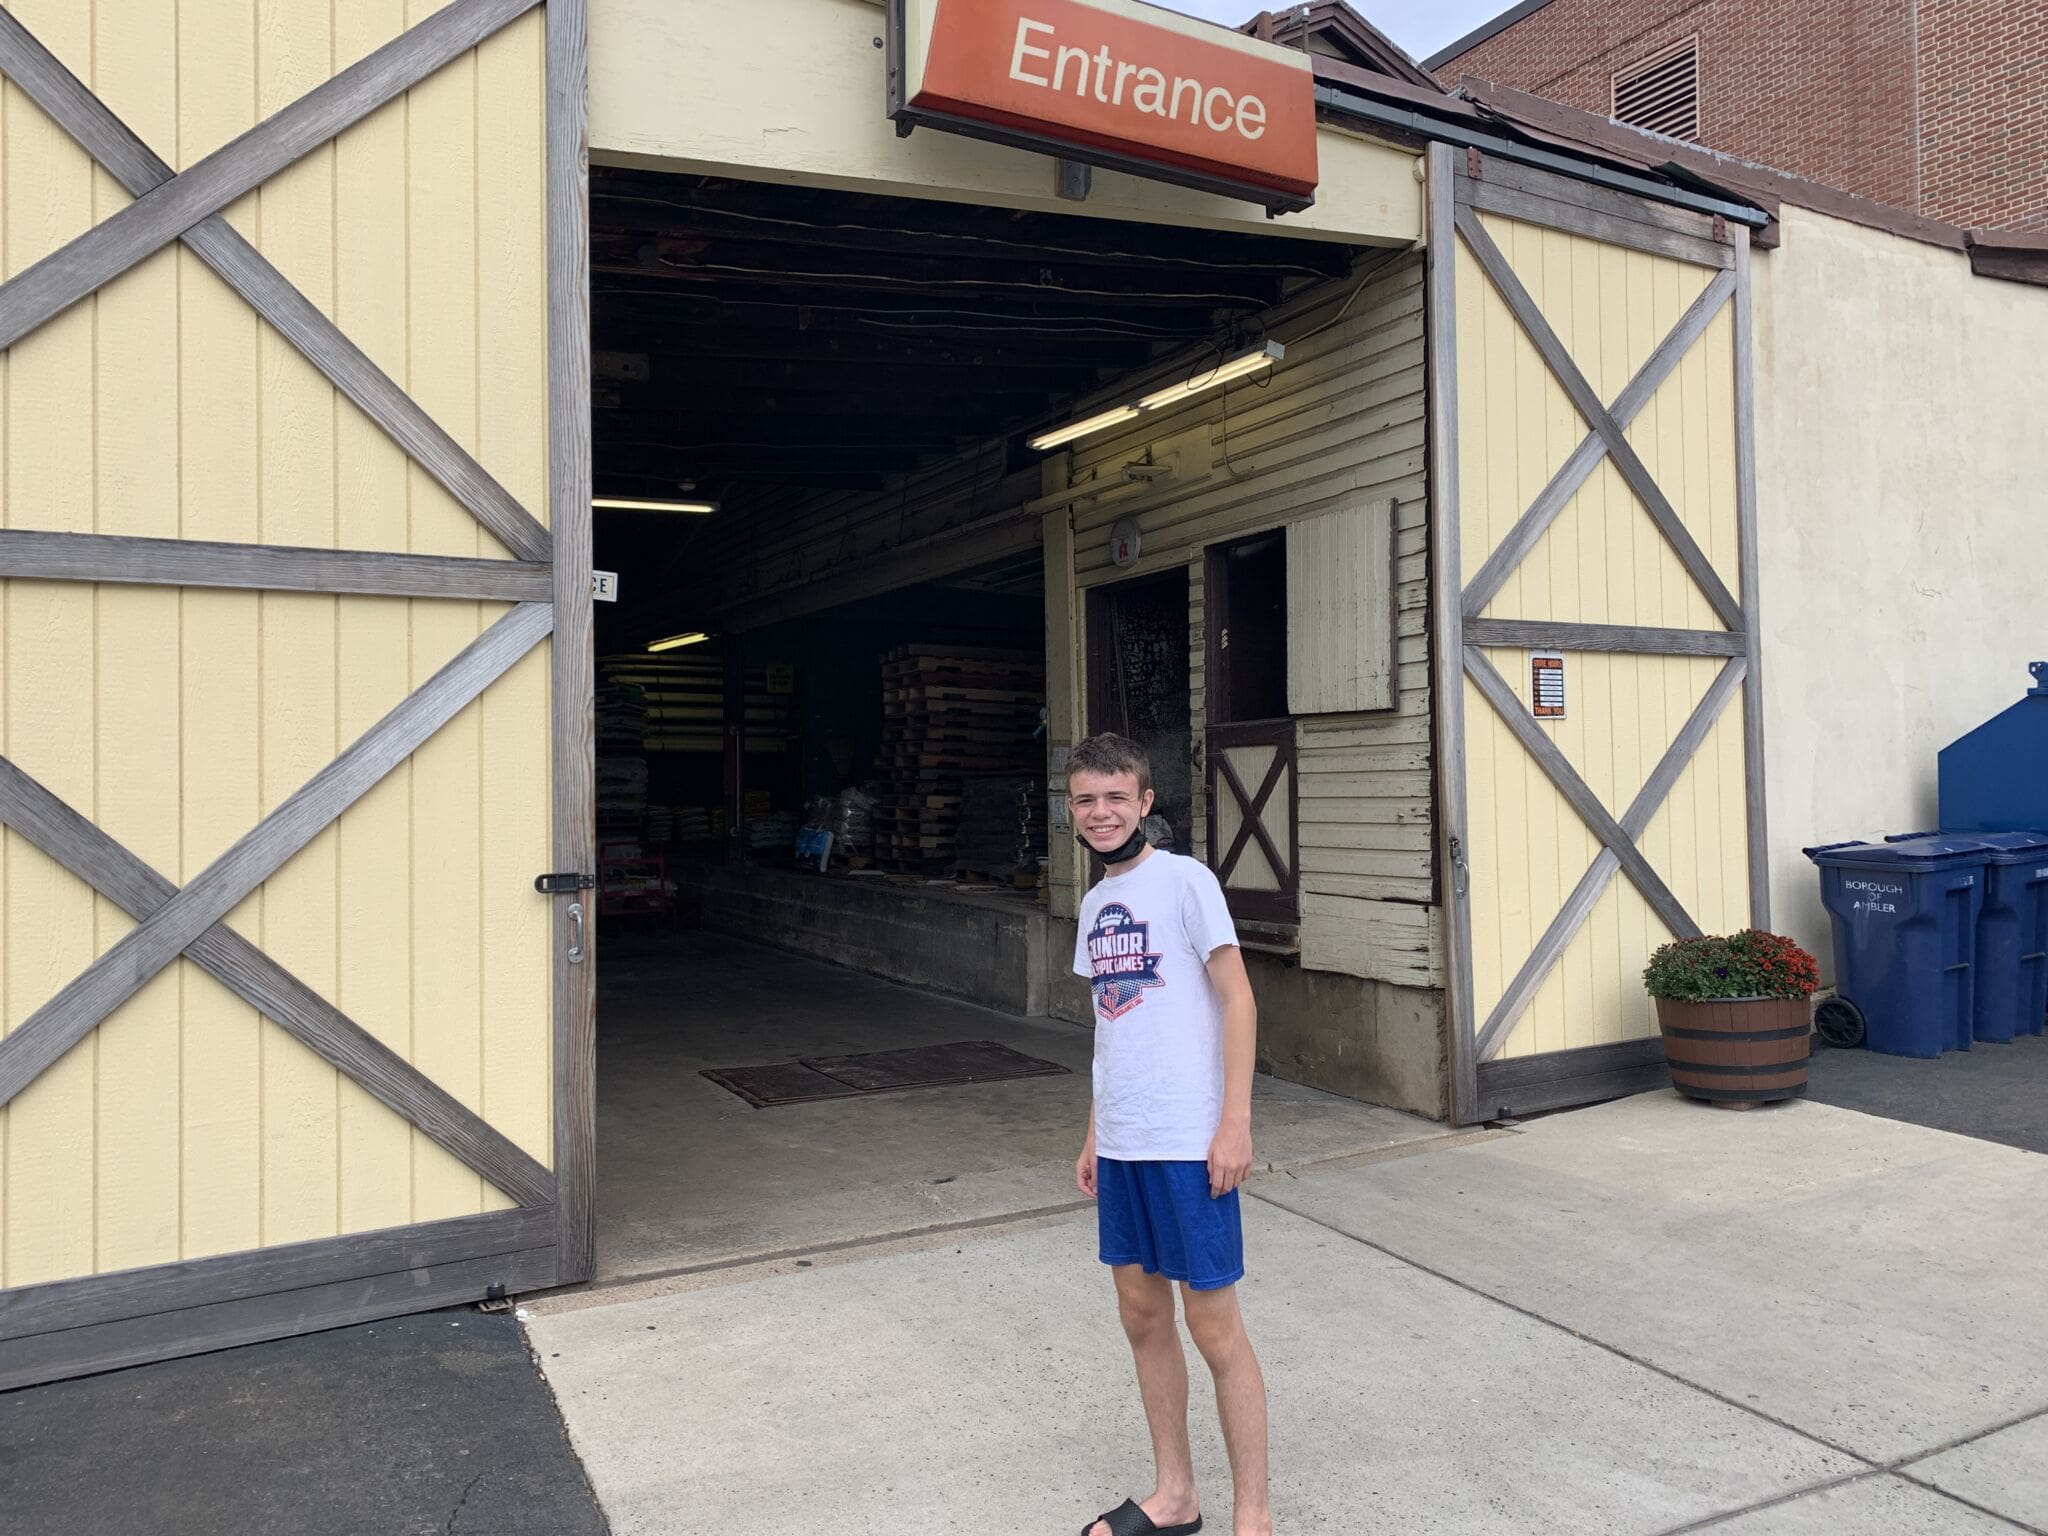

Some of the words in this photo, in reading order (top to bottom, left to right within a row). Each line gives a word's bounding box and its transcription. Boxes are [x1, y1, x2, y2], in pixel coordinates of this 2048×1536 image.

[1009, 17, 1266, 140] Entrance
[1845, 880, 1902, 894] BOROUGH
[1869, 892, 1881, 901] OF
[1853, 901, 1896, 913] AMBLER
[1114, 955, 1144, 973] GAMES
